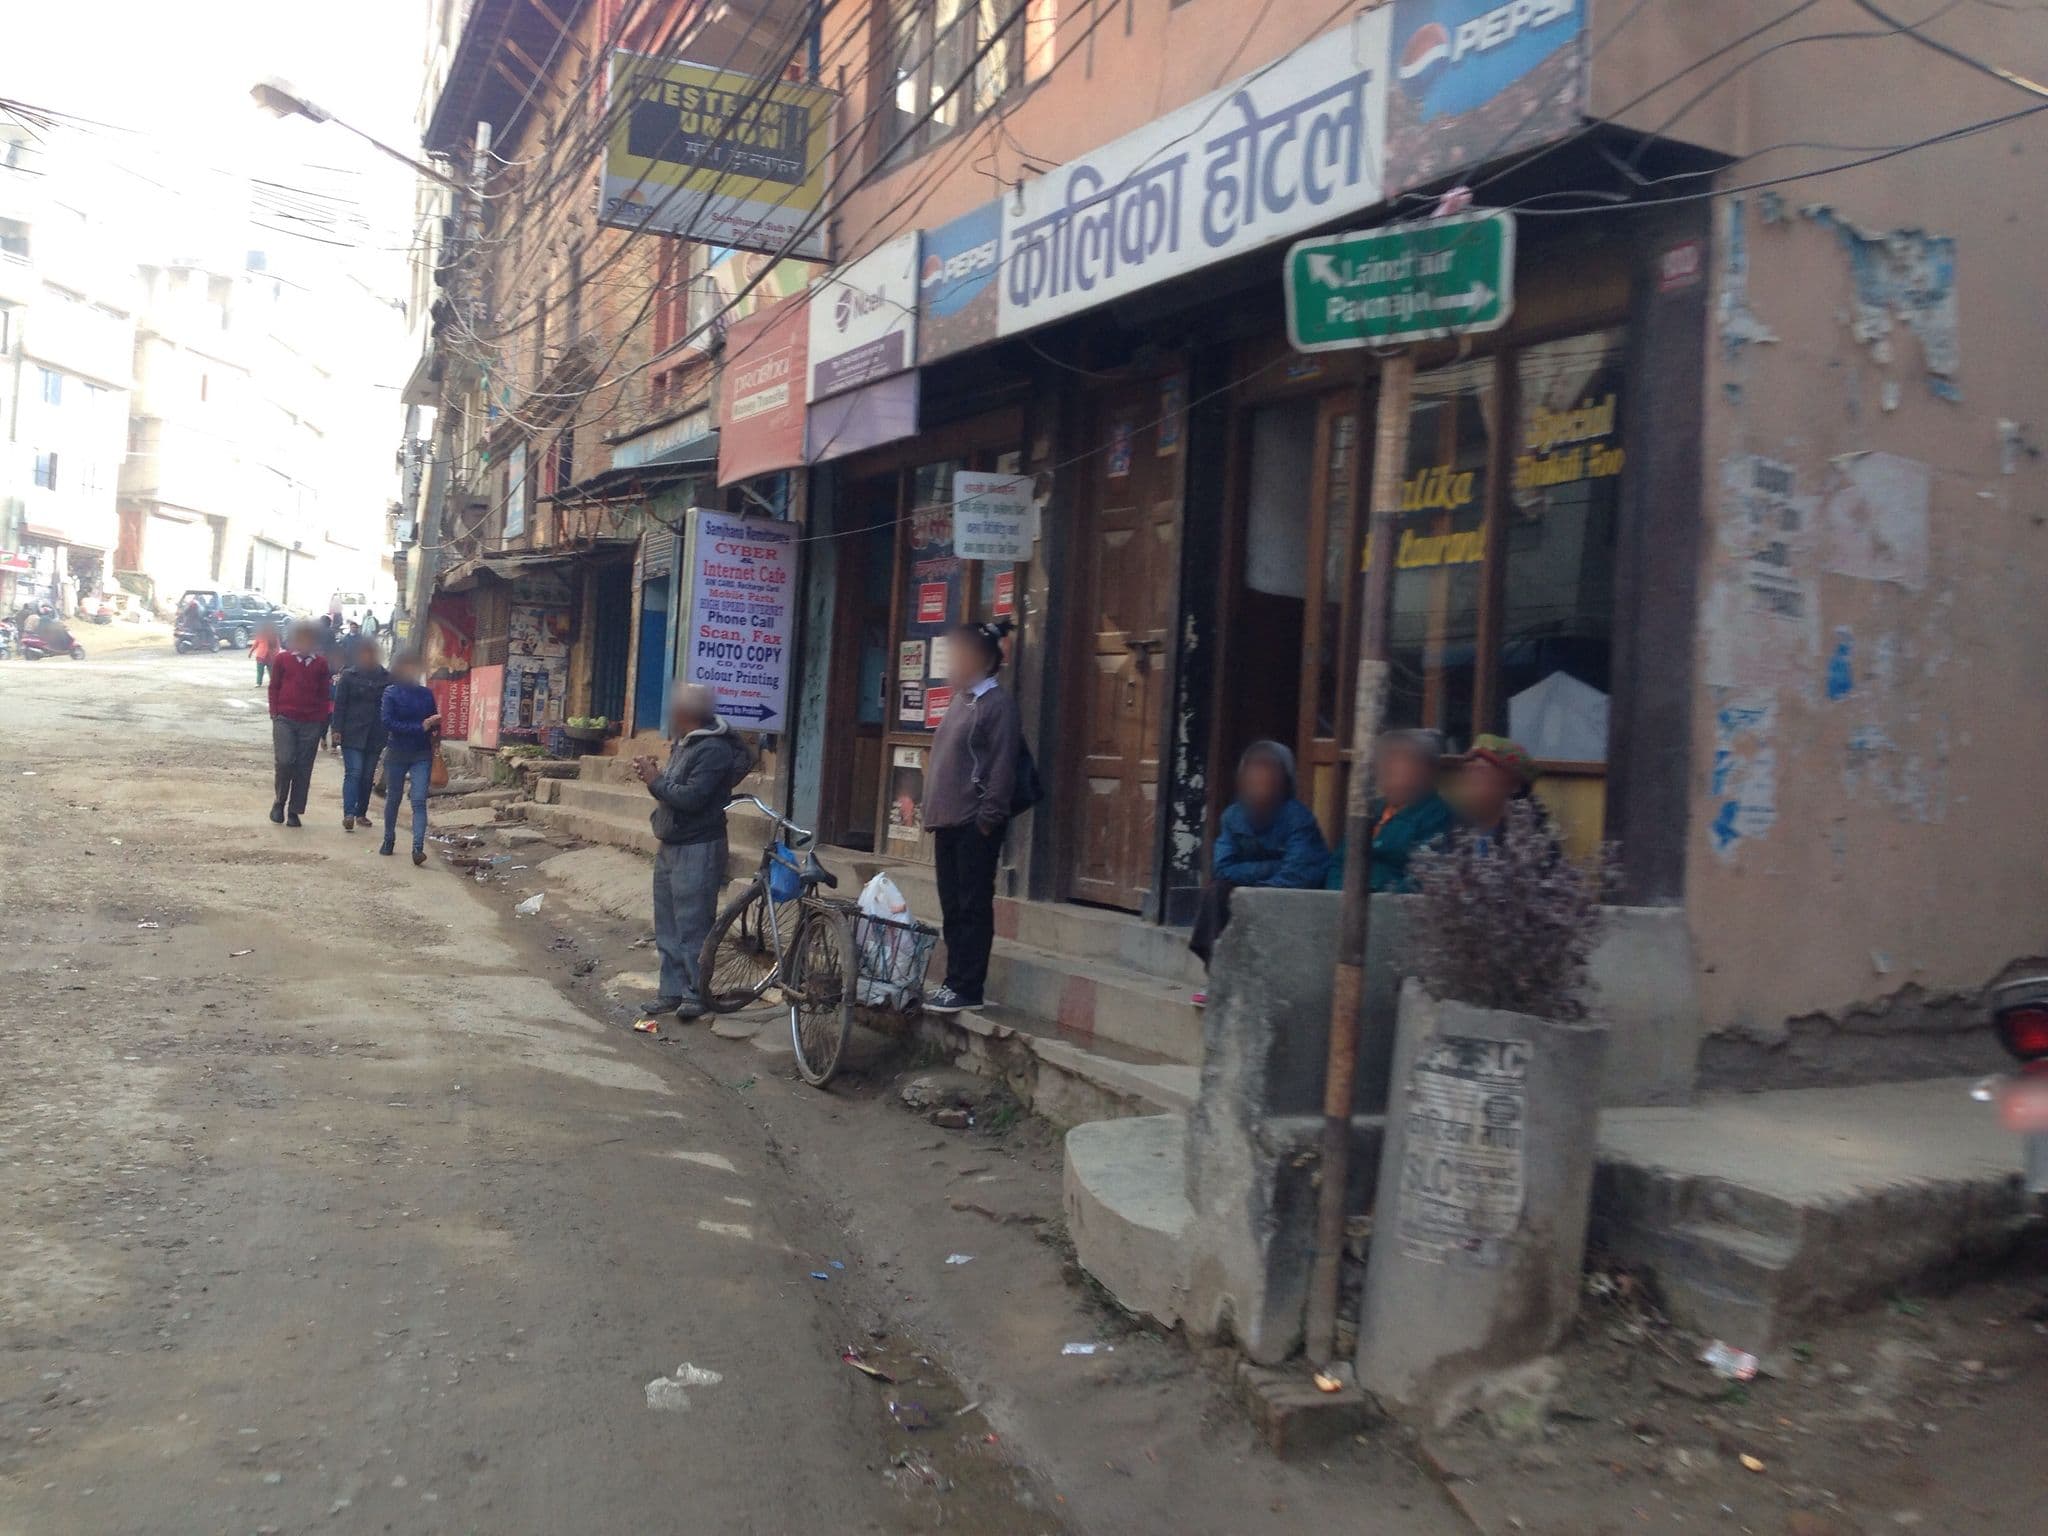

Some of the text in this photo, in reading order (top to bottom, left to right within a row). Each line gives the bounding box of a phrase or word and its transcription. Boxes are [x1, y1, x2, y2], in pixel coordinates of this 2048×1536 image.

[636, 82, 783, 124] WESTERN
[682, 111, 779, 149] UNION
[1008, 70, 1372, 308] कालिका होटल
[715, 543, 778, 560] CYBER
[704, 560, 786, 584] Internet Cafe
[700, 598, 784, 616] HIGH SPEED INTERNET
[709, 589, 775, 603] Mobile Parts
[708, 611, 774, 629] Phone Call
[700, 625, 782, 645] Scan, Fax
[698, 641, 782, 663] PHOTO COPY
[741, 662, 764, 671] DVD
[696, 667, 779, 690] Colour Printing
[446, 683, 458, 736] KHAJA GHAR
[459, 684, 470, 735] RAMECHHAP
